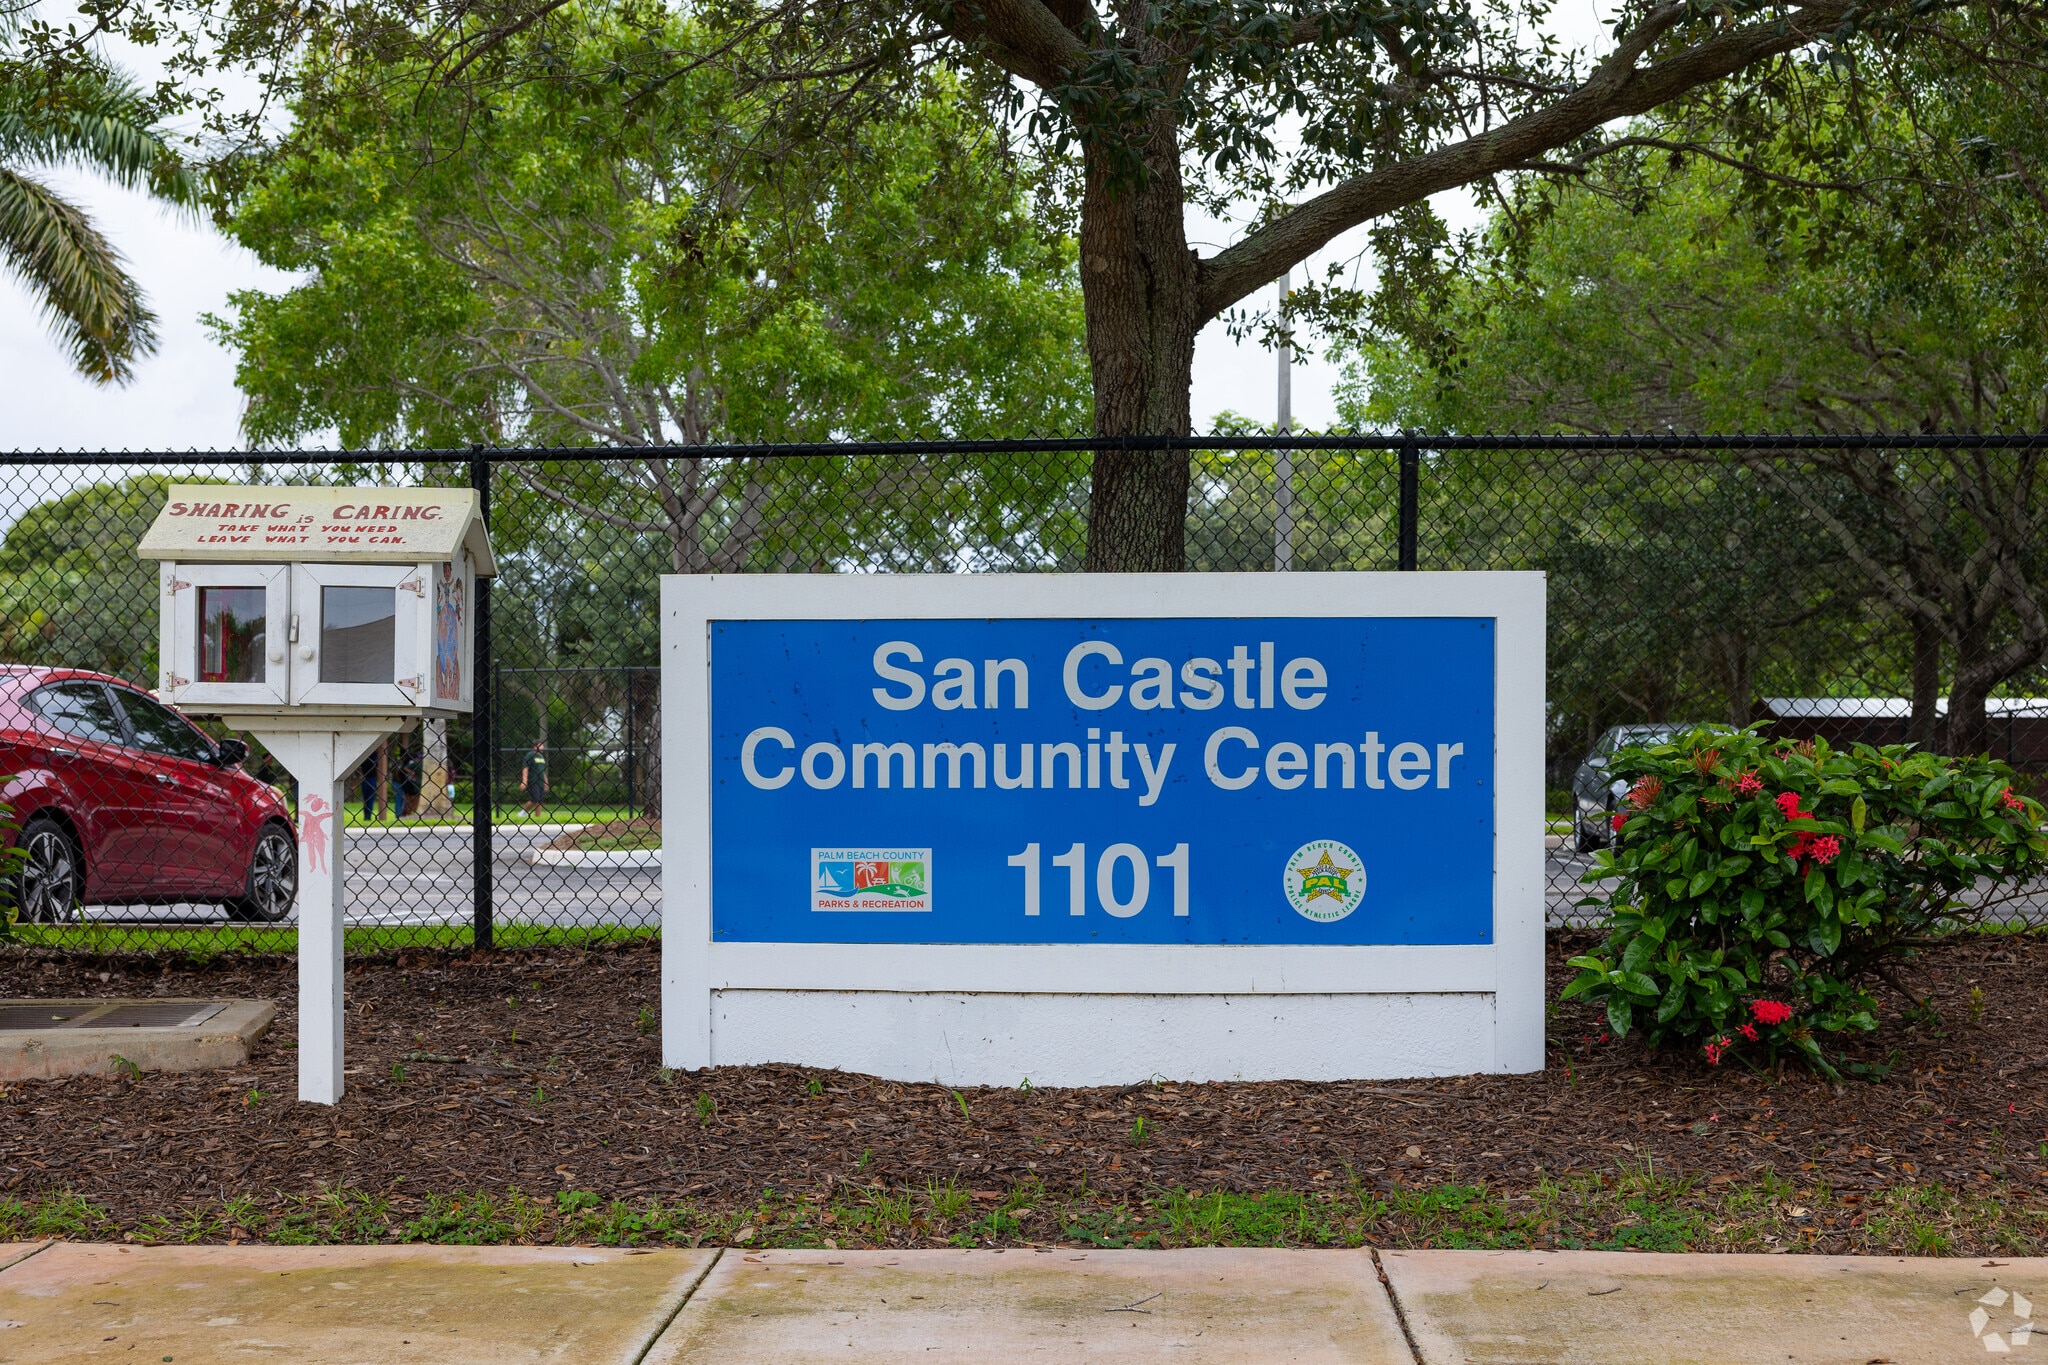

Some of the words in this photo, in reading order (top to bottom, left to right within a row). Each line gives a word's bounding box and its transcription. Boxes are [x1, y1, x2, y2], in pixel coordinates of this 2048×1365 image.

[169, 502, 291, 518] SHARING
[296, 514, 315, 524] is
[332, 505, 443, 520] CARING.
[197, 535, 252, 543] LEAVE
[218, 524, 260, 532] TAKE
[321, 525, 351, 533] YOU
[355, 525, 398, 533] NEED
[873, 641, 1029, 711] San
[1063, 641, 1328, 711] Castle
[741, 726, 1177, 807] Community
[1204, 726, 1464, 790] Center
[818, 851, 844, 860] PALM
[846, 851, 880, 860] BEACH
[882, 851, 924, 860] COUNTY
[1287, 851, 1303, 871] PALM
[1306, 842, 1334, 852] BEACH
[1338, 846, 1362, 872] COUNTY
[1007, 842, 1189, 917] 1101
[1305, 877, 1345, 889] PAL
[818, 900, 850, 908] PARKS
[852, 900, 859, 908] &
[862, 900, 924, 908] RECREATION
[1287, 885, 1303, 909] POLICE
[1304, 908, 1340, 919] ATHLETIC
[1341, 890, 1361, 913] LEAGUE
